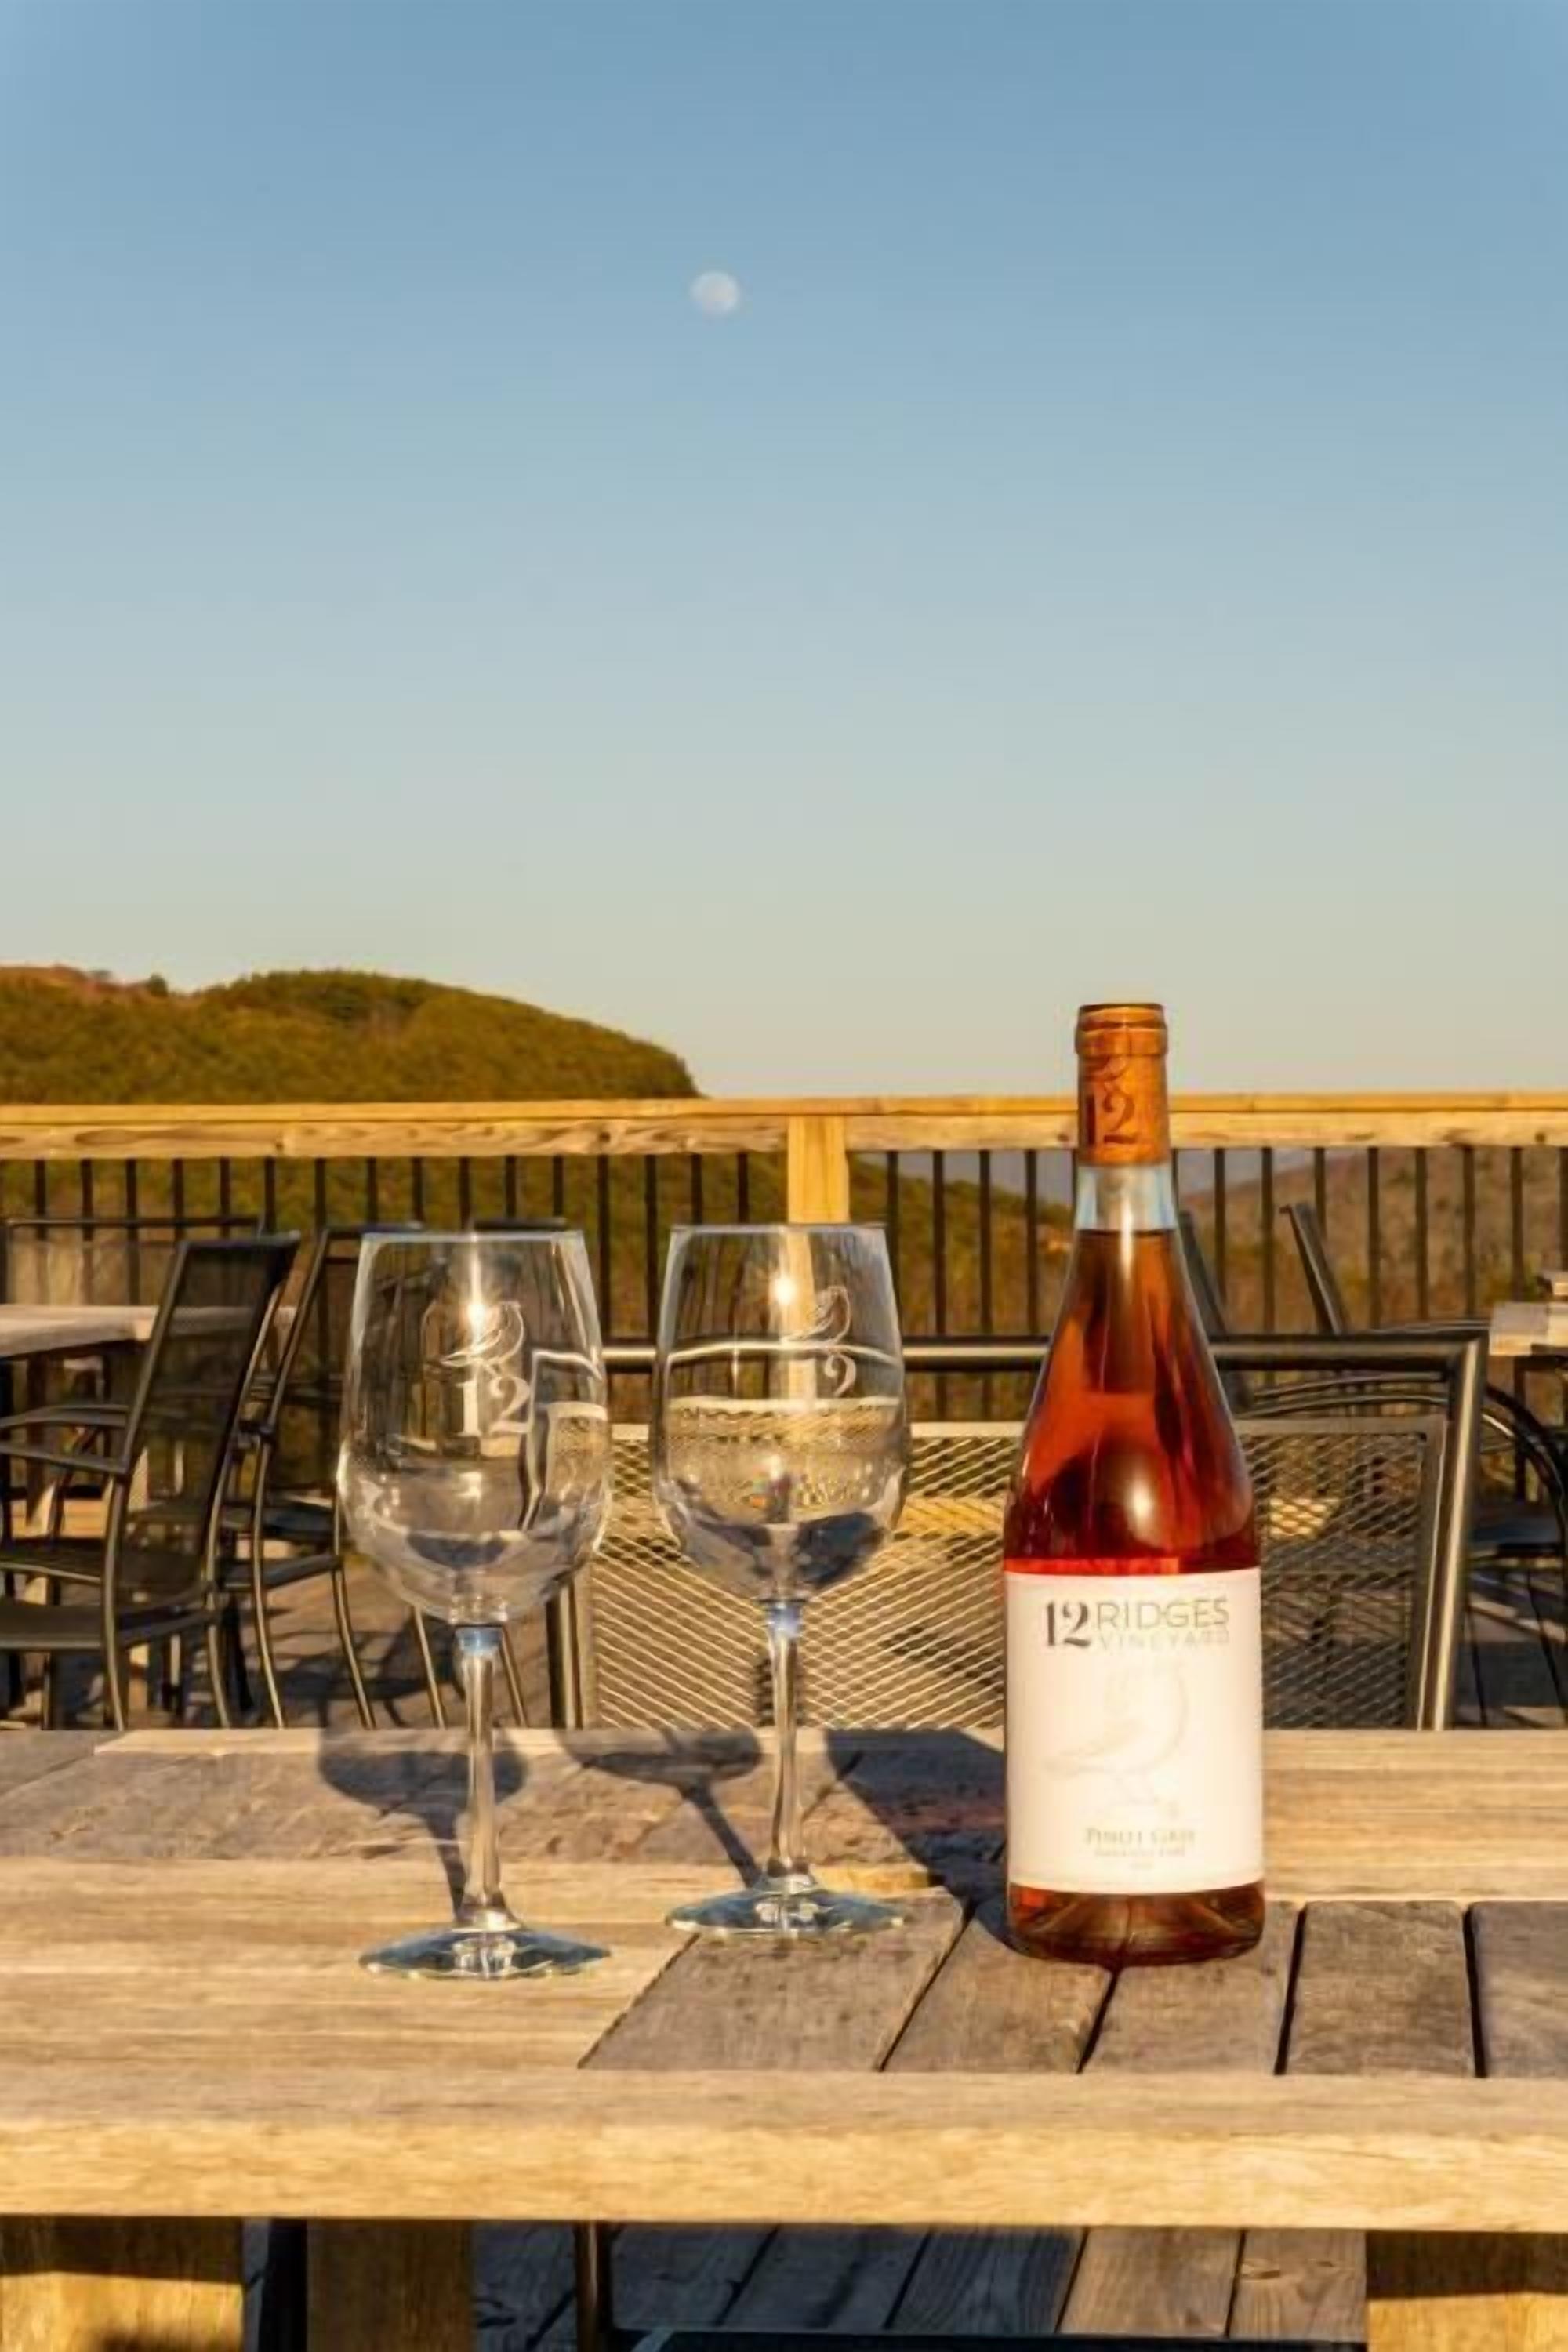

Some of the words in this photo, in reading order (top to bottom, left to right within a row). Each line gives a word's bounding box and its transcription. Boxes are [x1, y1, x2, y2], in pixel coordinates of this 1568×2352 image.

[1086, 1088, 1139, 1145] 12
[456, 1376, 531, 1437] 12
[1045, 1599, 1093, 1649] 12
[1096, 1596, 1230, 1630] RIDGES
